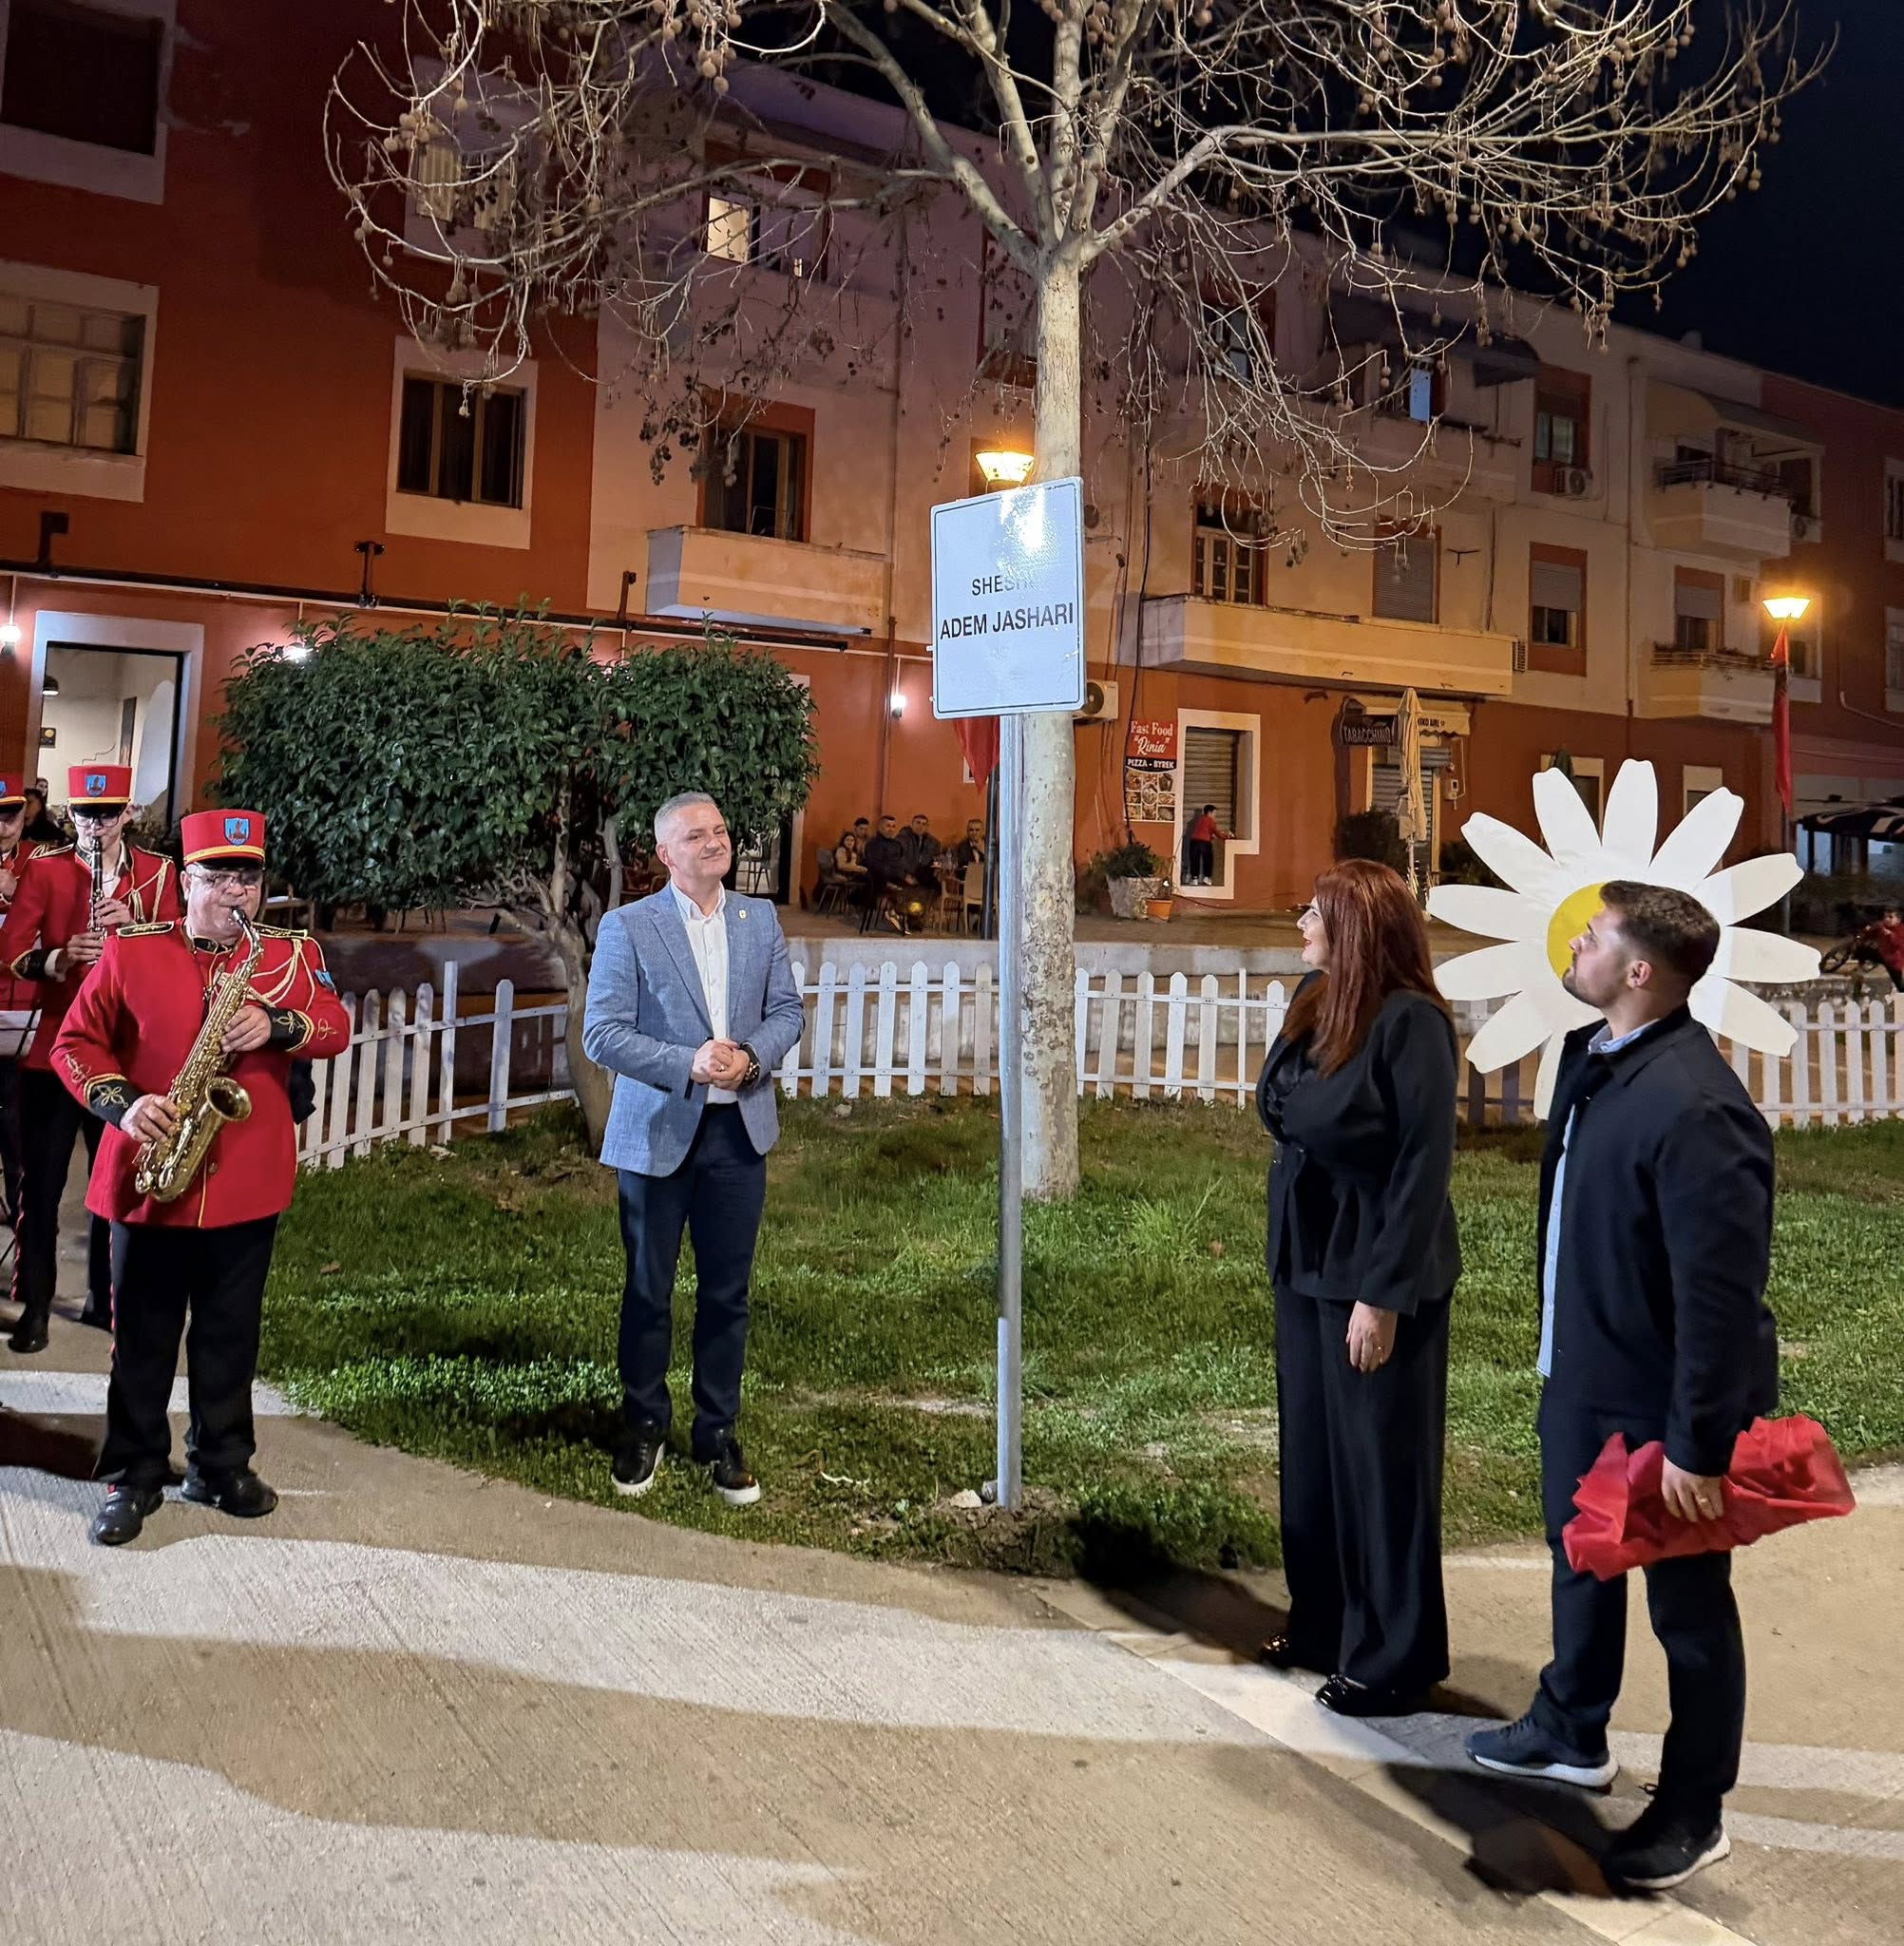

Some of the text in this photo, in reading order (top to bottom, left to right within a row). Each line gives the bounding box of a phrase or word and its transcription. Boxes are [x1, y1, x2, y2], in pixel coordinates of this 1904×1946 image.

[940, 602, 1074, 639] ADEM JASHARI
[1131, 720, 1173, 735] Fast Food
[1343, 726, 1391, 743] TABACCHINO
[1127, 758, 1148, 767] PIZZA
